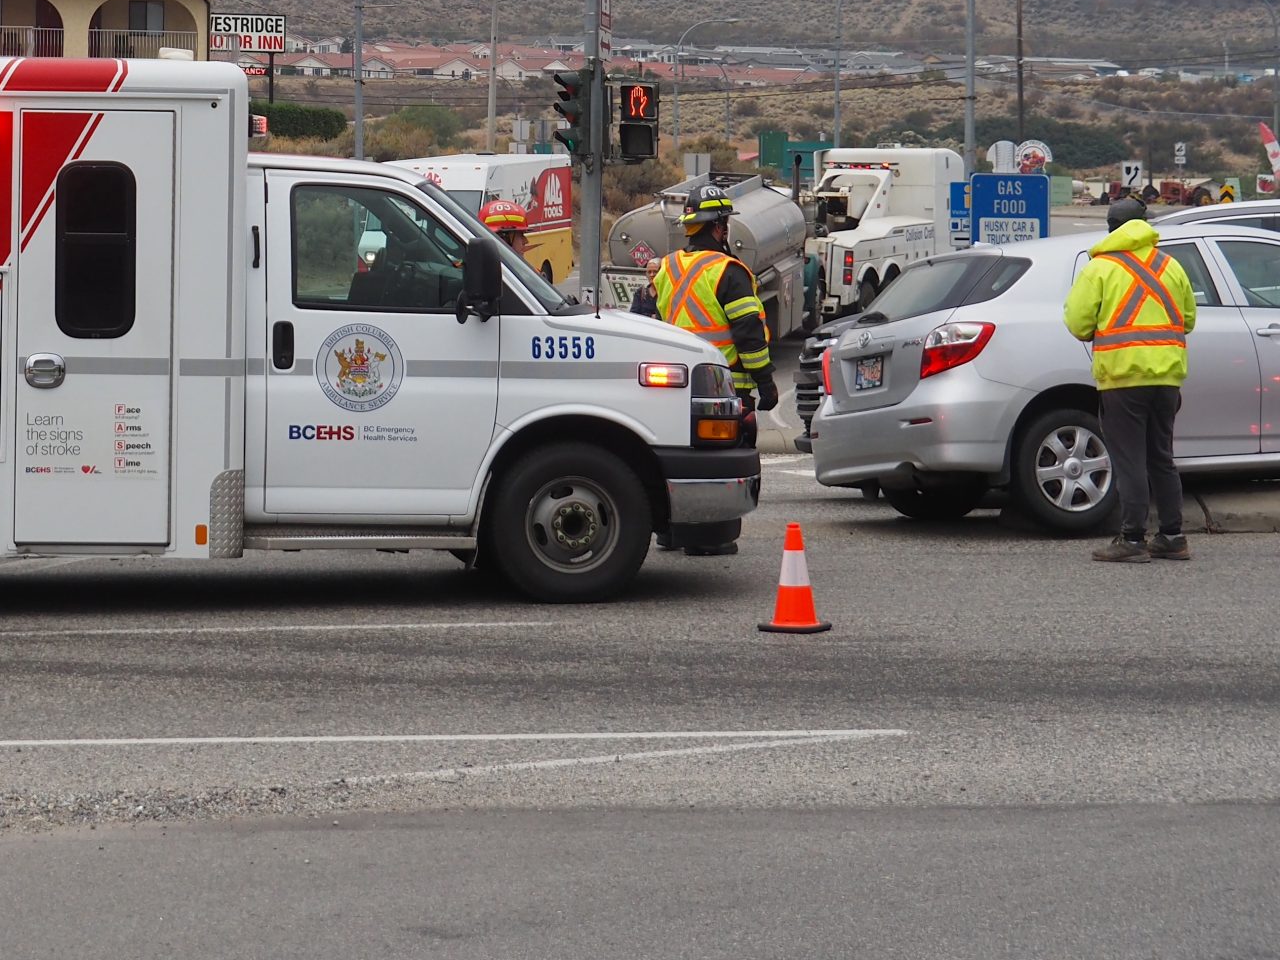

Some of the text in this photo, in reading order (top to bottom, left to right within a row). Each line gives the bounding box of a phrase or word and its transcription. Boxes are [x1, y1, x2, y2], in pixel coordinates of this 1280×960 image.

[258, 35, 283, 50] INN
[997, 180, 1023, 195] GAS
[543, 205, 563, 218] TOOLS
[993, 199, 1026, 214] FOOD
[984, 221, 1035, 232] HUSKY CAR &
[986, 233, 1011, 245] TRUCK
[325, 325, 395, 349] BRITISH COLUMBIA
[531, 336, 595, 359] 63558
[321, 381, 398, 411] AMBULANCE SERVICE
[116, 405, 141, 414] Face
[26, 412, 64, 426] Learn
[116, 423, 142, 432] Arms
[376, 426, 415, 434] Emergency
[26, 428, 84, 444] the signs
[387, 434, 417, 442] Services
[26, 442, 81, 456] of stroke
[116, 441, 151, 450] Speech
[116, 458, 141, 467] Time
